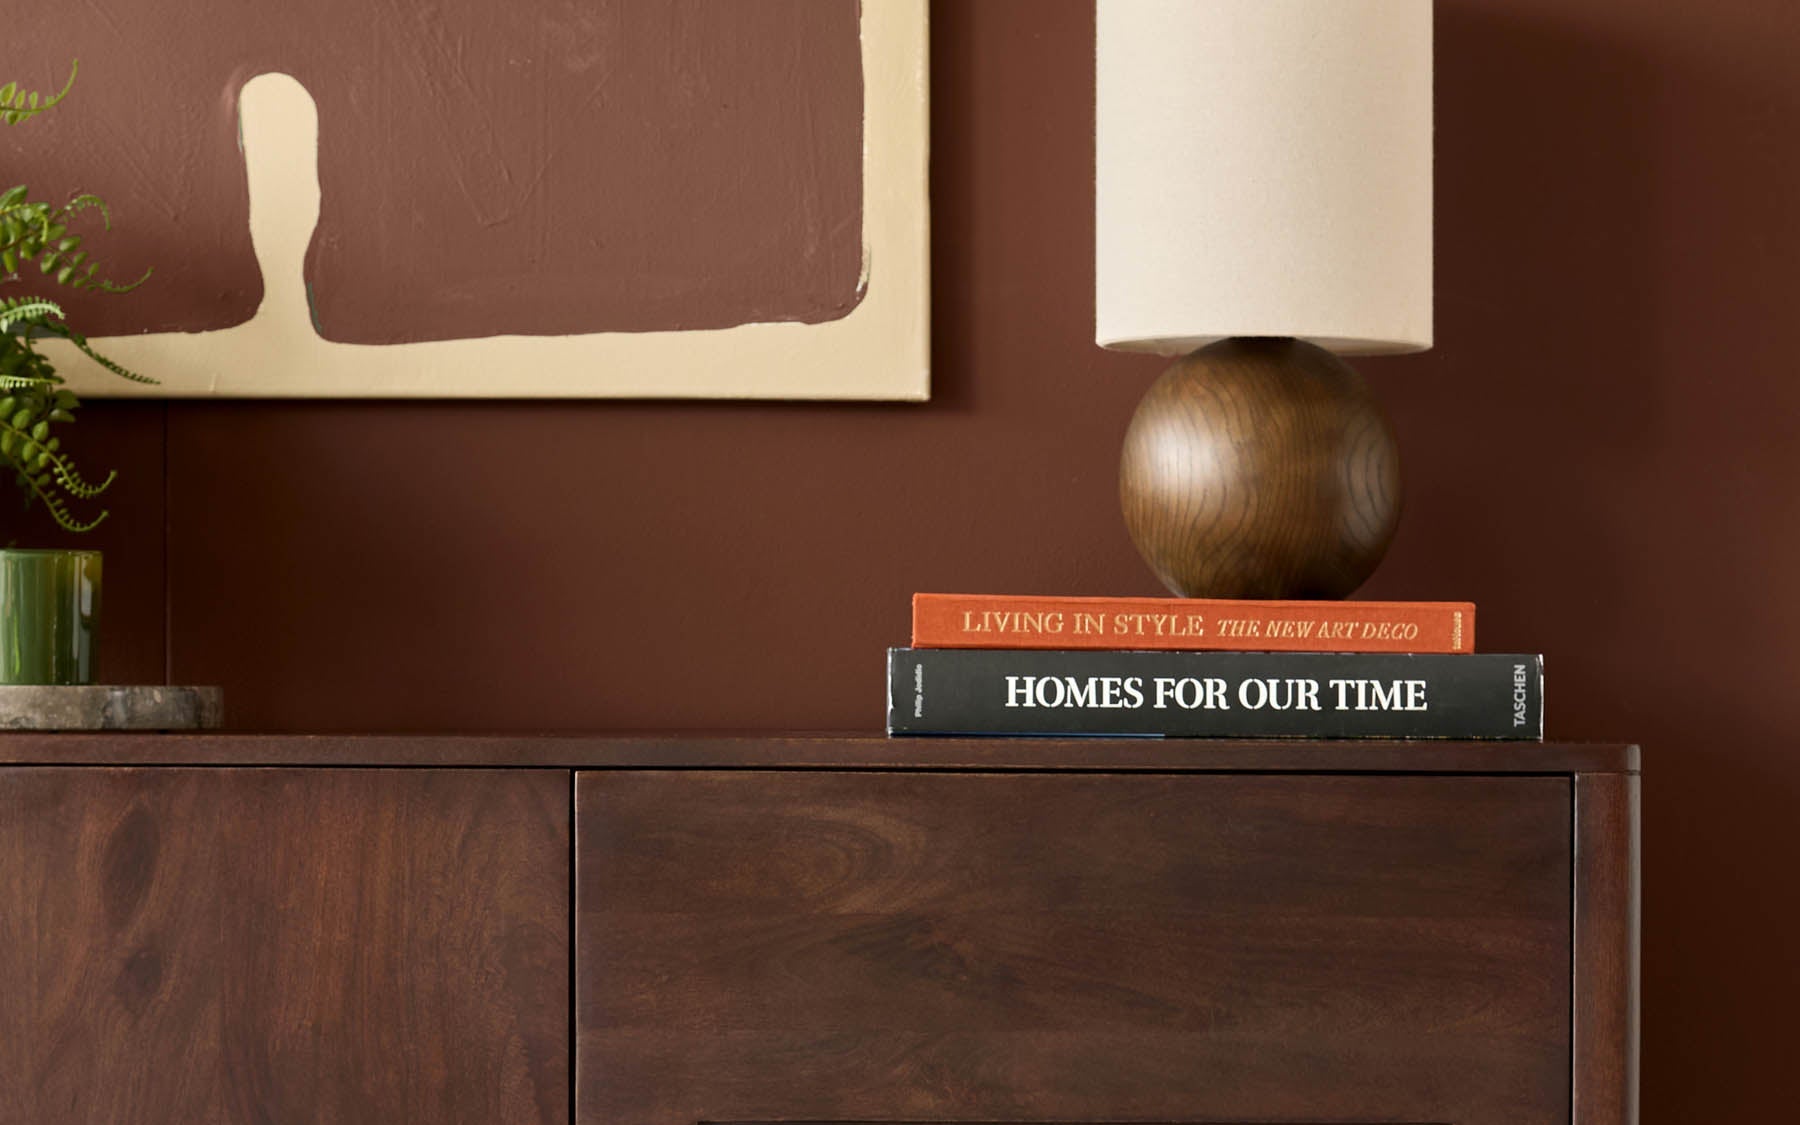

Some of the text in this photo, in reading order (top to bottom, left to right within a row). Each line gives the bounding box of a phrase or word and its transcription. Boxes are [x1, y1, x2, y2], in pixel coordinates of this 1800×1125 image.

[962, 610, 1419, 641] LIVING IN STYLE THE NEW ART DECO
[1004, 675, 1429, 712] HOMES FOR OUR TIME
[1513, 664, 1526, 728] TASCHEN
